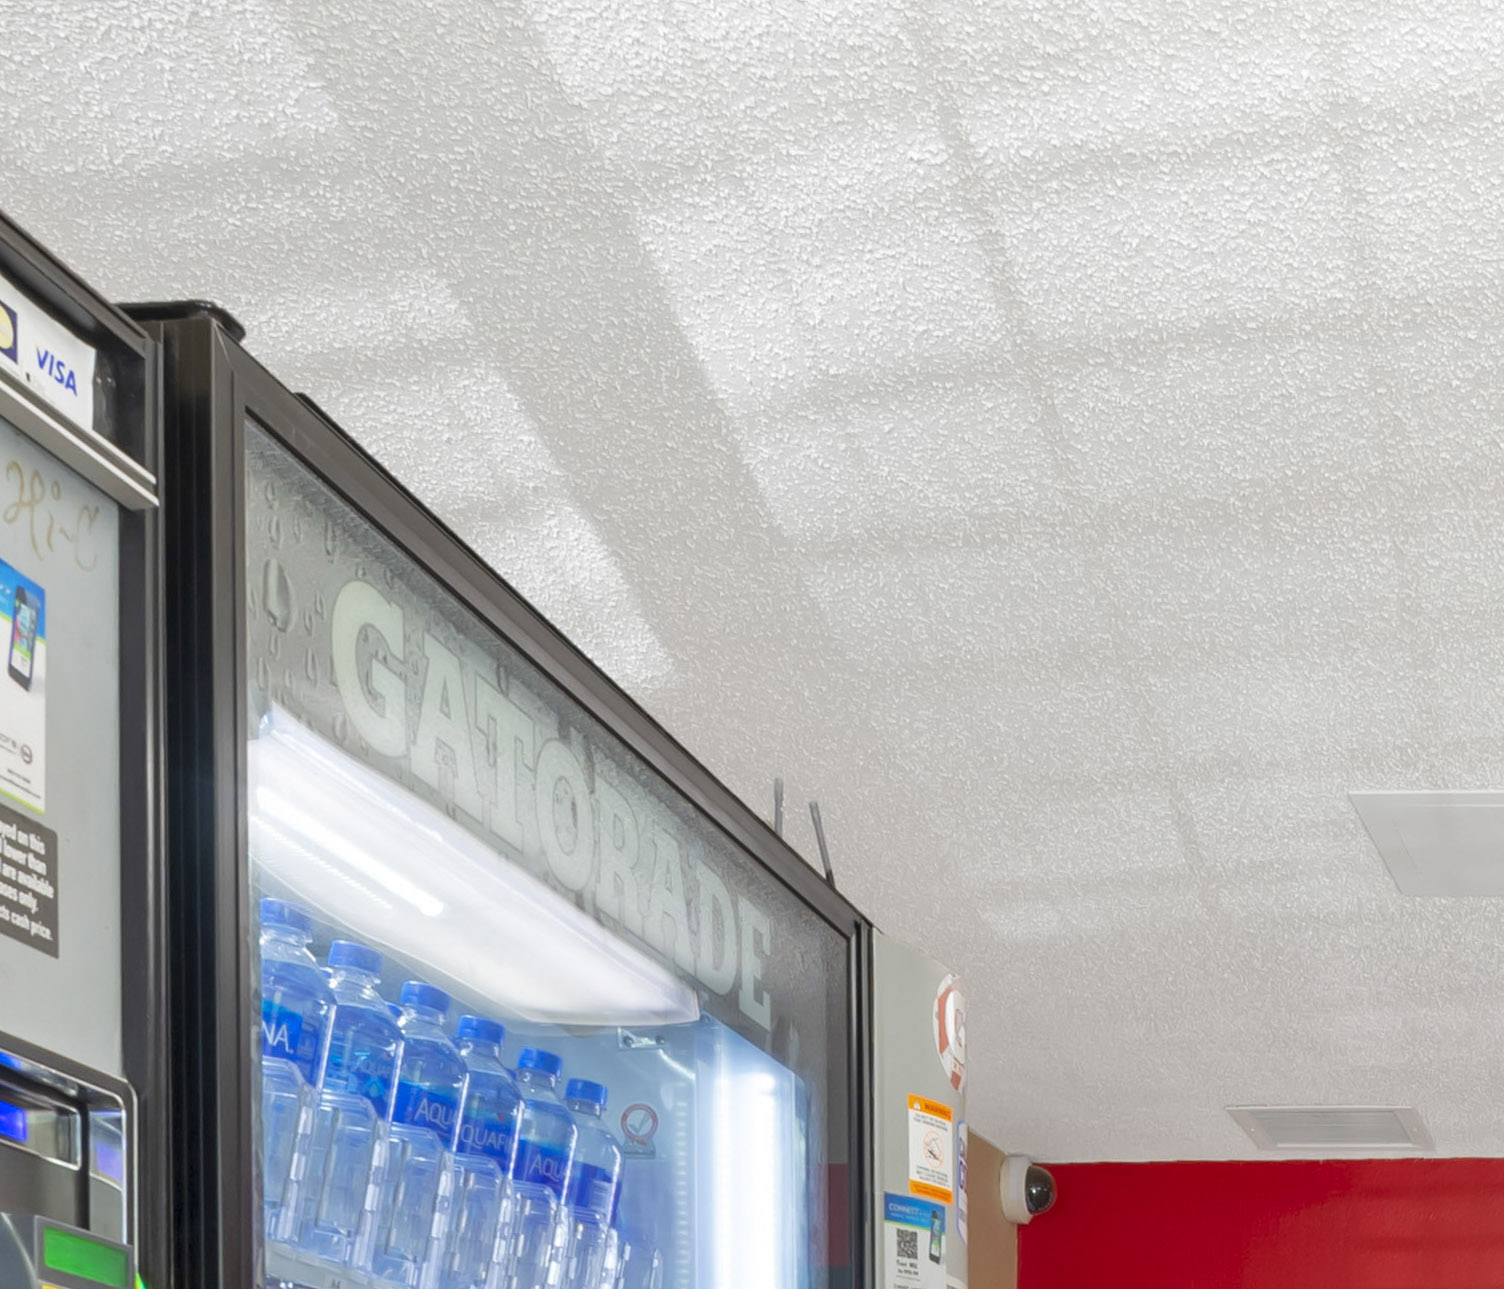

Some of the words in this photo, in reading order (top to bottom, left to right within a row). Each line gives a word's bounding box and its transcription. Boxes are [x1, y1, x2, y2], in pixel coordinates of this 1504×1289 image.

[35, 346, 78, 397] VISA
[331, 580, 773, 1033] GATORADE
[3, 841, 27, 866] lower
[27, 852, 47, 876] than
[17, 830, 29, 846] on
[29, 833, 45, 855] this
[2, 863, 17, 881] are
[17, 870, 55, 899] available
[18, 891, 39, 914] only.
[11, 912, 30, 931] cash
